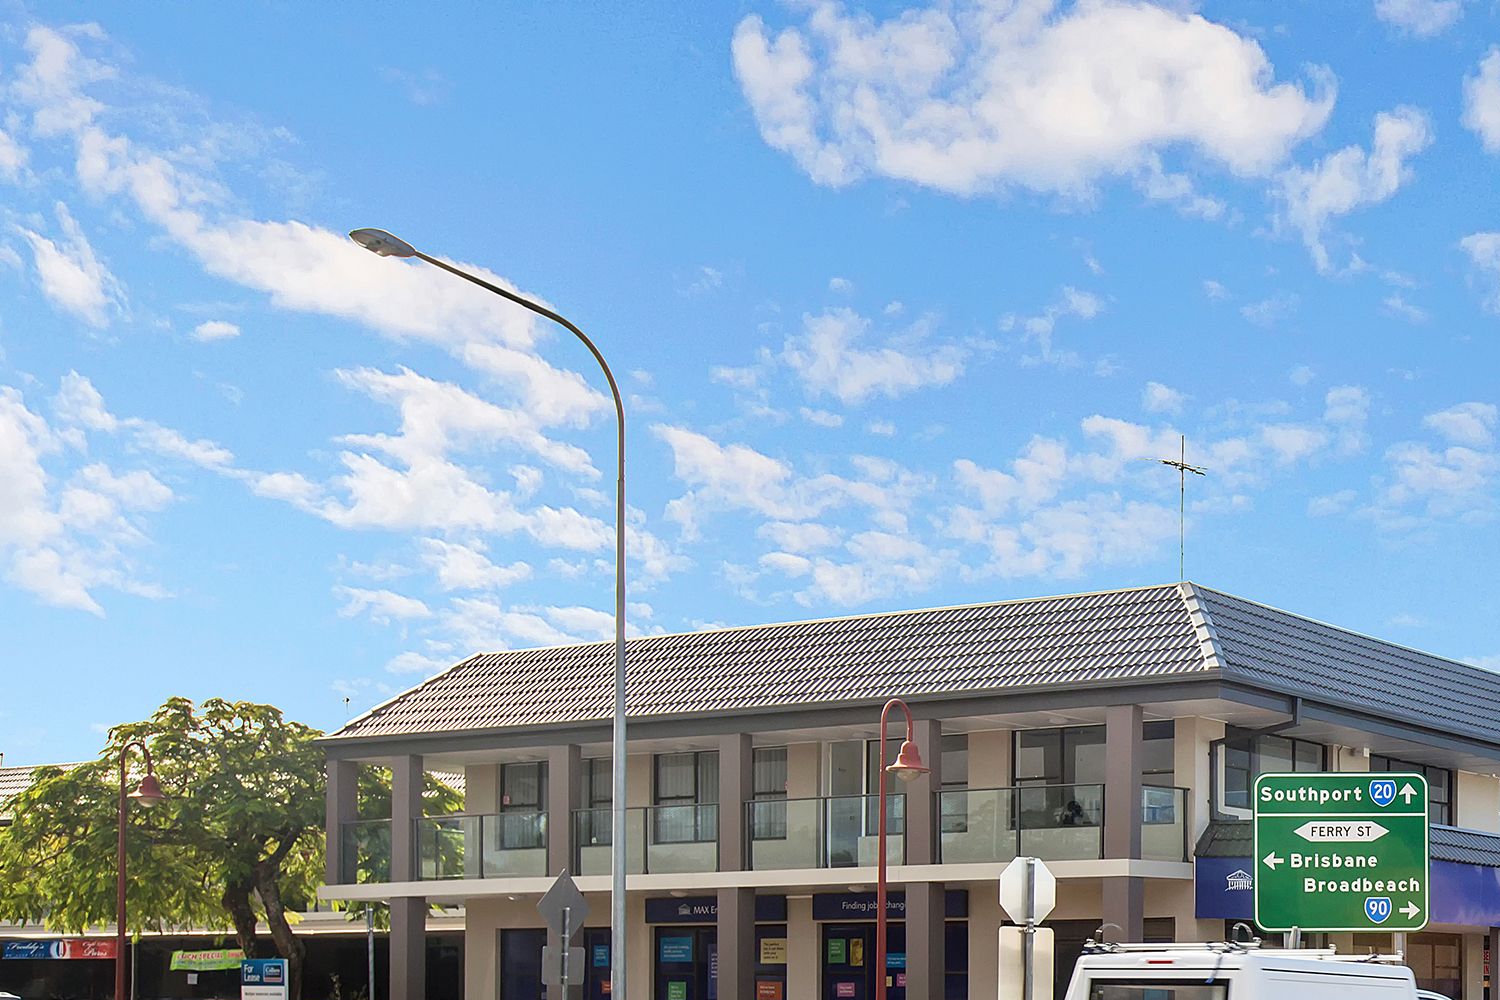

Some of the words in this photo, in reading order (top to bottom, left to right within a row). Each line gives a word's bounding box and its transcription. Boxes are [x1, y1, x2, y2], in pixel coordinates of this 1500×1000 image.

[1260, 786, 1362, 804] Southport
[1373, 783, 1393, 799] 20
[1310, 826, 1352, 837] FERRY
[1357, 826, 1372, 837] ST
[1290, 853, 1378, 868] Brisbane
[1304, 877, 1420, 893] Broadbeach
[693, 906, 710, 915] MAX
[842, 901, 866, 912] Finding
[1368, 900, 1388, 916] 90
[243, 963, 254, 973] For
[243, 972, 261, 982] Lease
